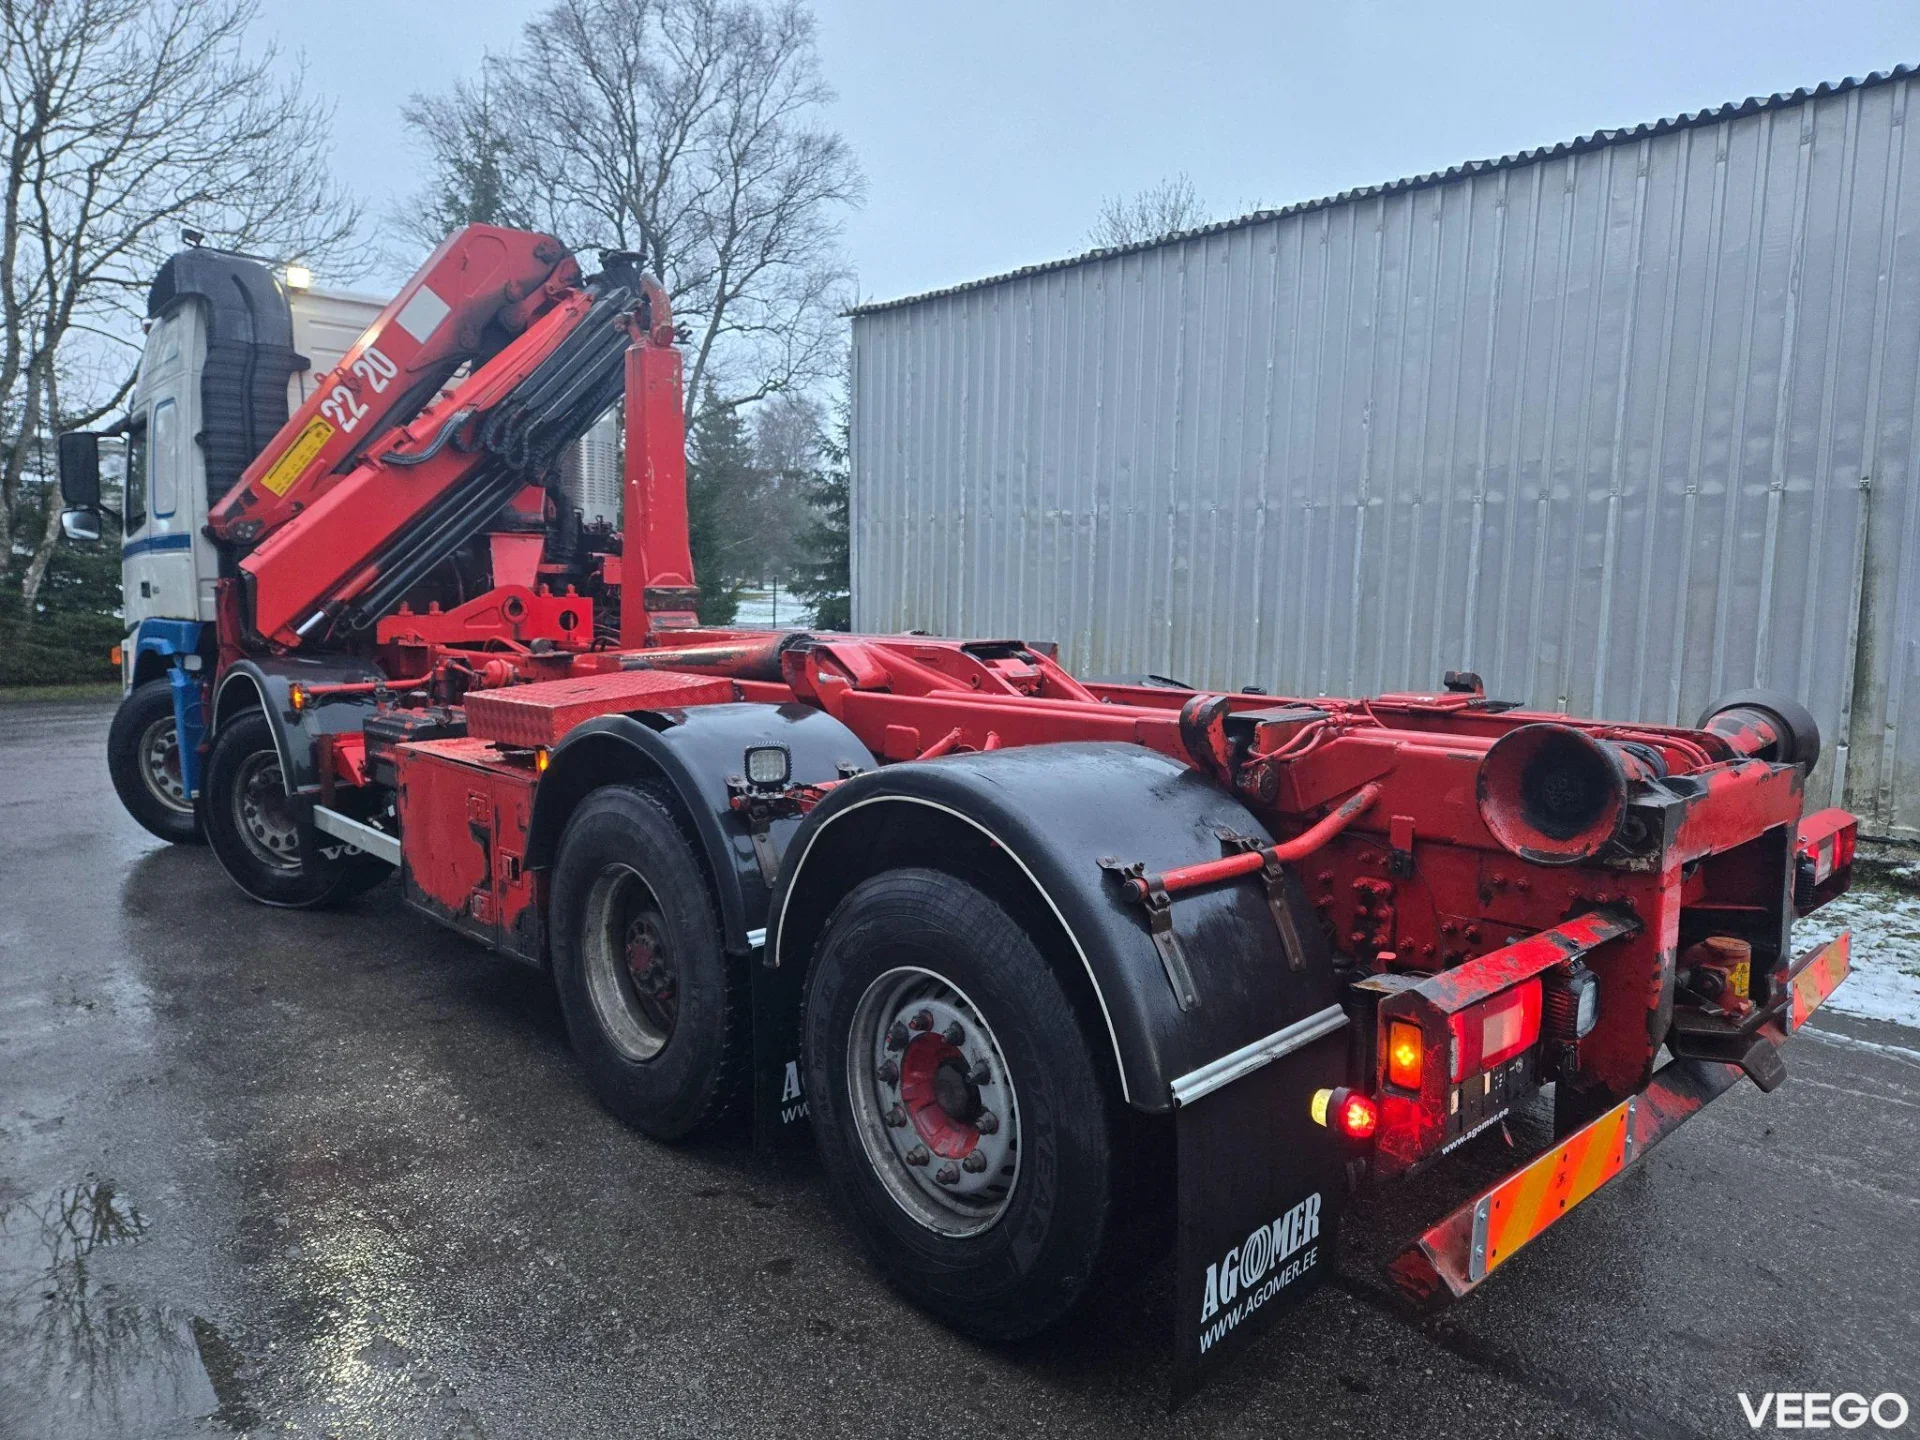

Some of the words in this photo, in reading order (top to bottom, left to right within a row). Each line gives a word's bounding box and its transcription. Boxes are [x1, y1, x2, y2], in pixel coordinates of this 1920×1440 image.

[320, 385, 369, 433] 22
[352, 347, 398, 394] 20
[319, 844, 366, 860] VO
[781, 1060, 803, 1103] A
[1442, 1107, 1509, 1155] www.agomer.ee
[1200, 1192, 1322, 1324] AGOMER
[1200, 1246, 1318, 1354] WWW.AGOMER.EE
